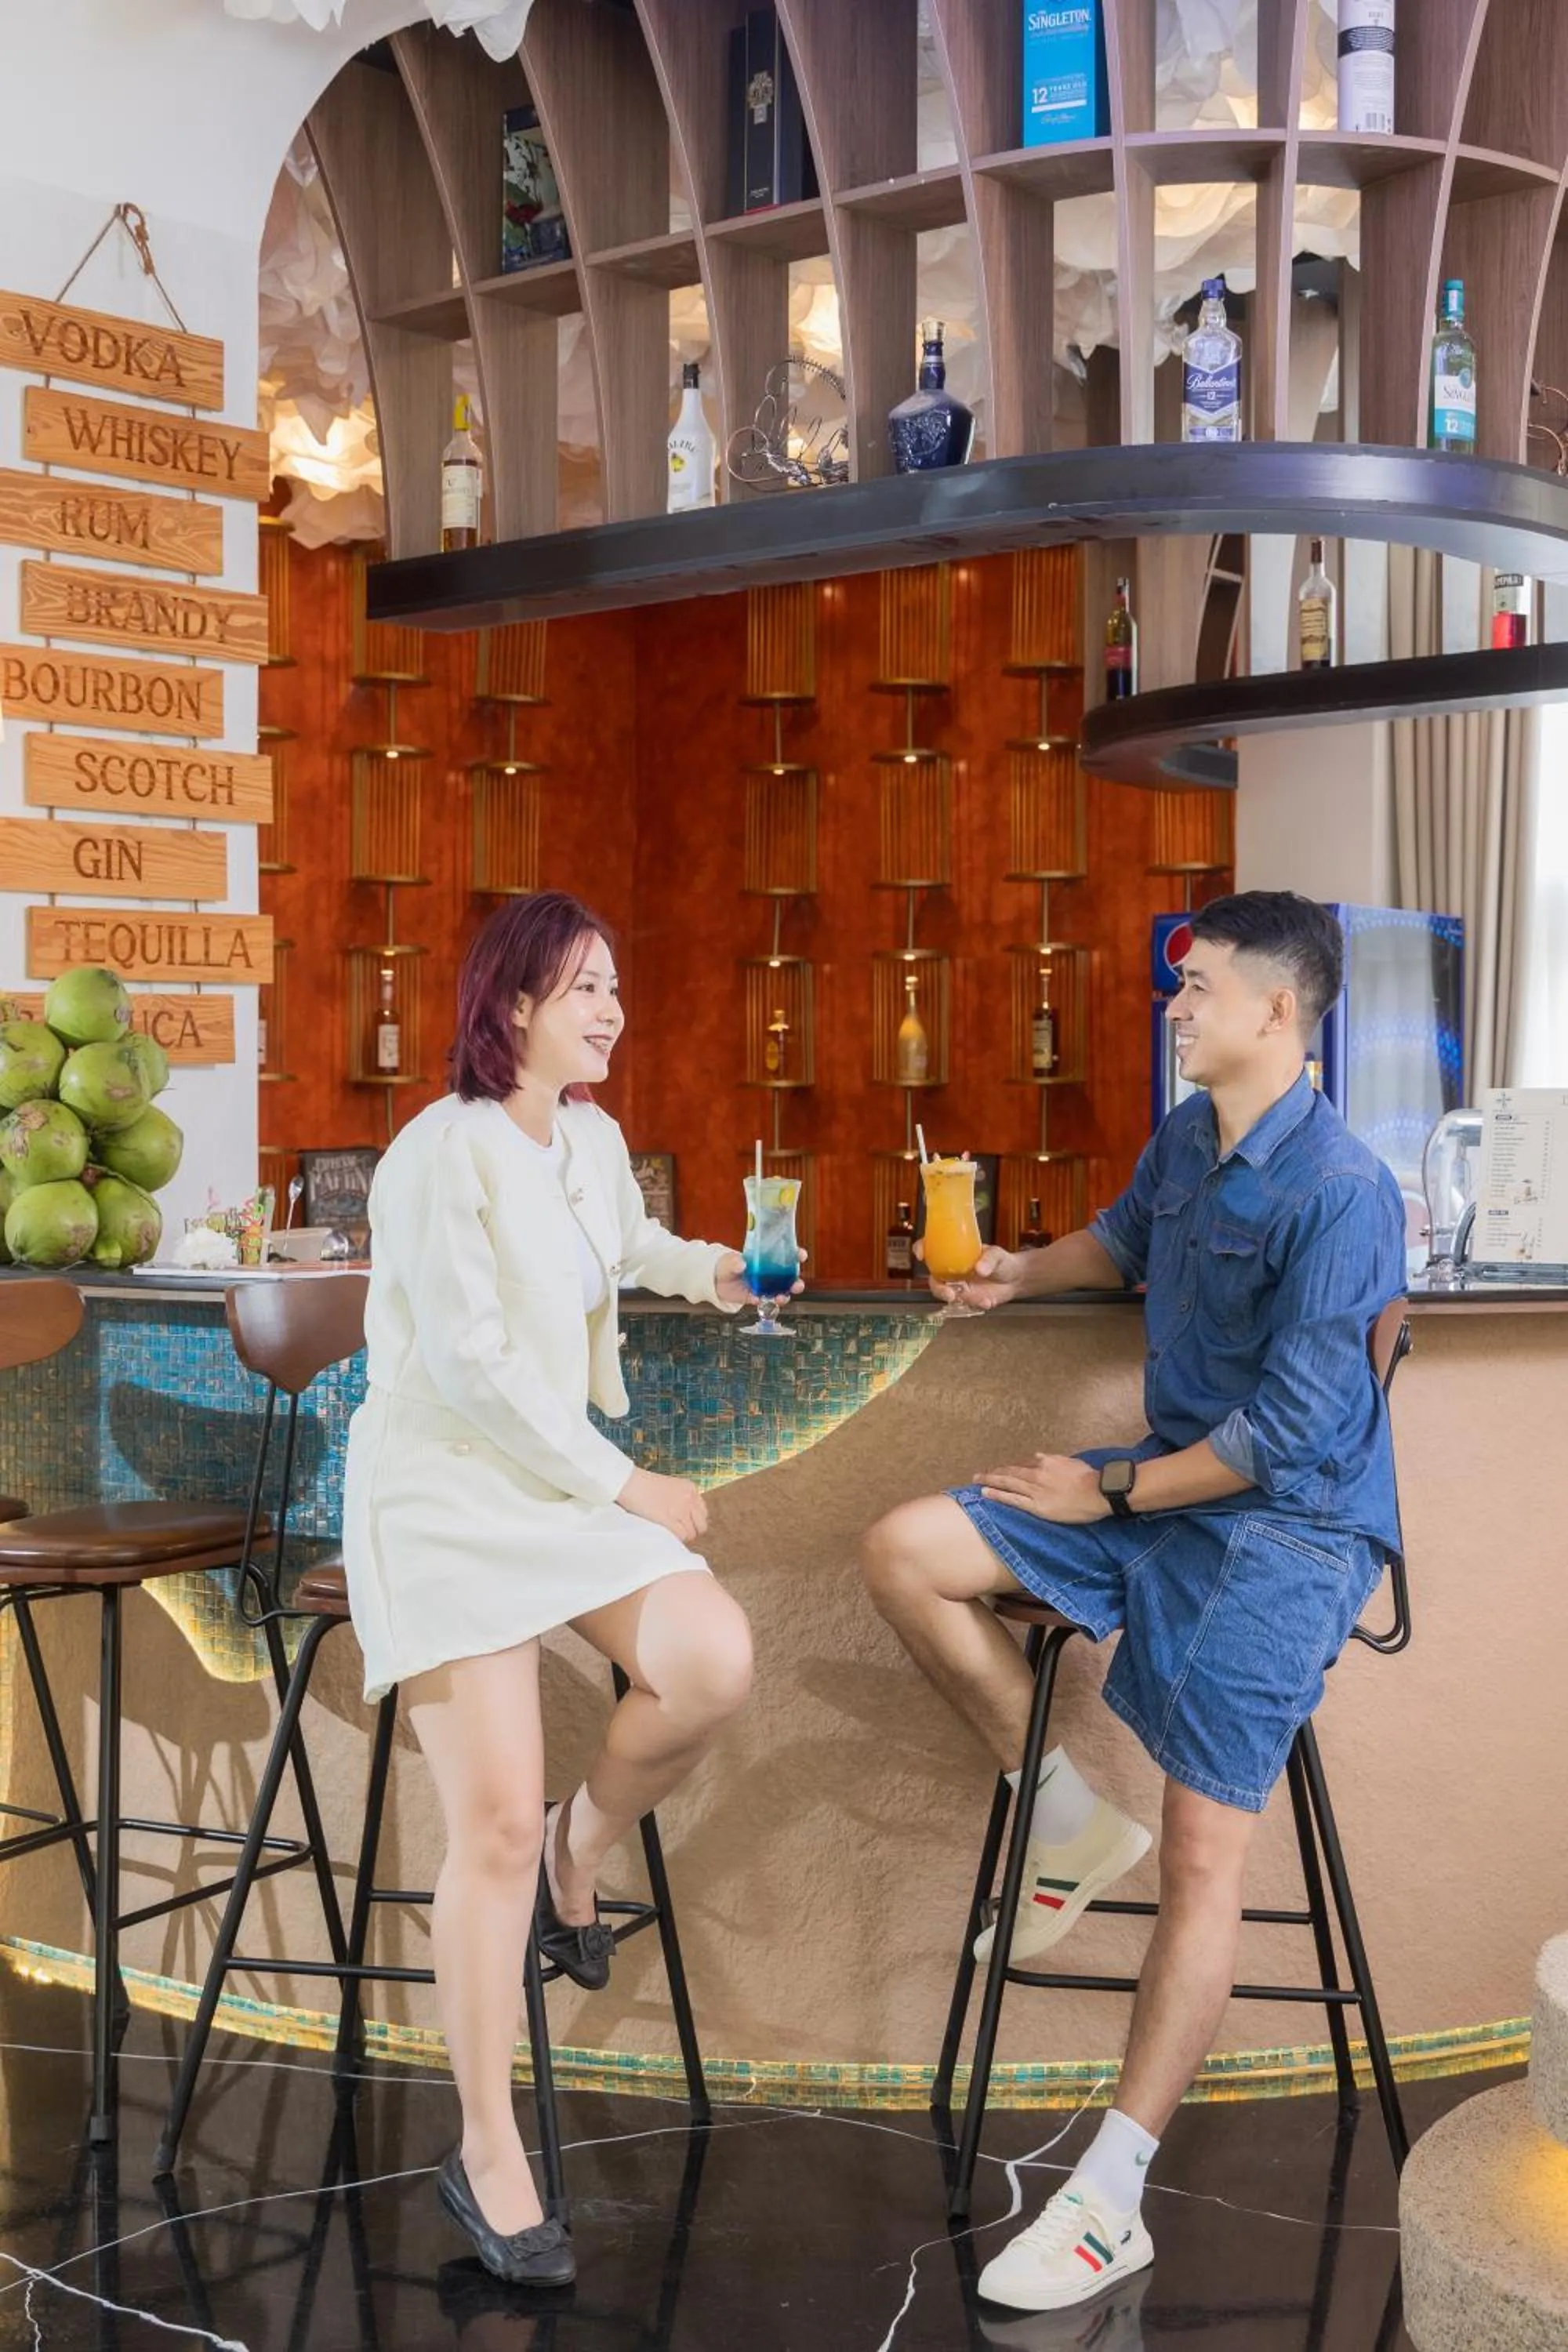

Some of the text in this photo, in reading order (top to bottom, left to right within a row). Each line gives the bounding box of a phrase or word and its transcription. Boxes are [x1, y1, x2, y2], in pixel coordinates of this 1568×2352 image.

[1032, 87, 1048, 104] 12
[20, 310, 186, 387] VODKA
[62, 406, 243, 481] WHISKEY
[60, 498, 151, 550] RUM
[66, 583, 233, 644] BRANDY
[3, 658, 202, 720] BOURBON
[74, 751, 235, 805] SCOTCH
[73, 837, 143, 881] GIN
[54, 920, 254, 970] TEQUILLA
